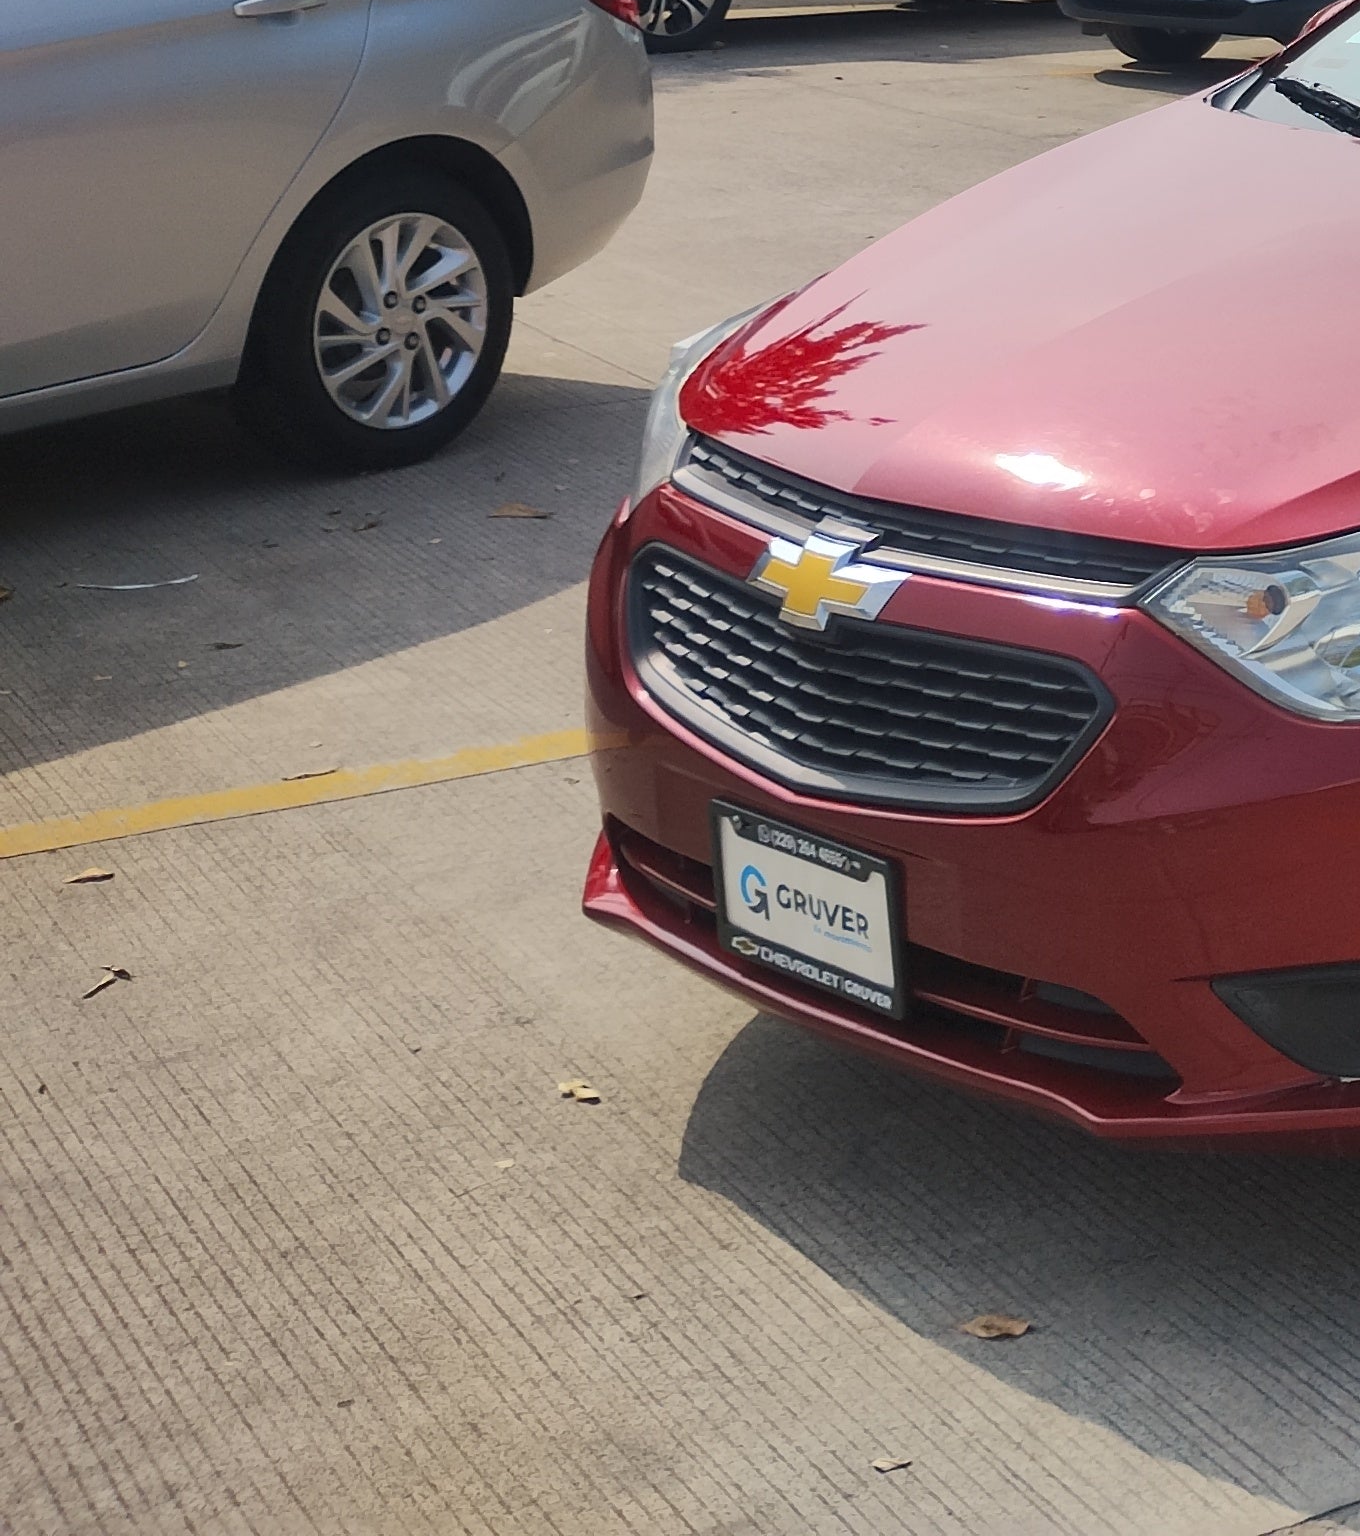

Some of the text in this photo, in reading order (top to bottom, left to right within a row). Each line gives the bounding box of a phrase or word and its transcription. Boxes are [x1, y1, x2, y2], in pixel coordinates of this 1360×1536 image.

[775, 883, 870, 940] GRUVER
[760, 945, 893, 1010] CHEVROLET GRUVER
